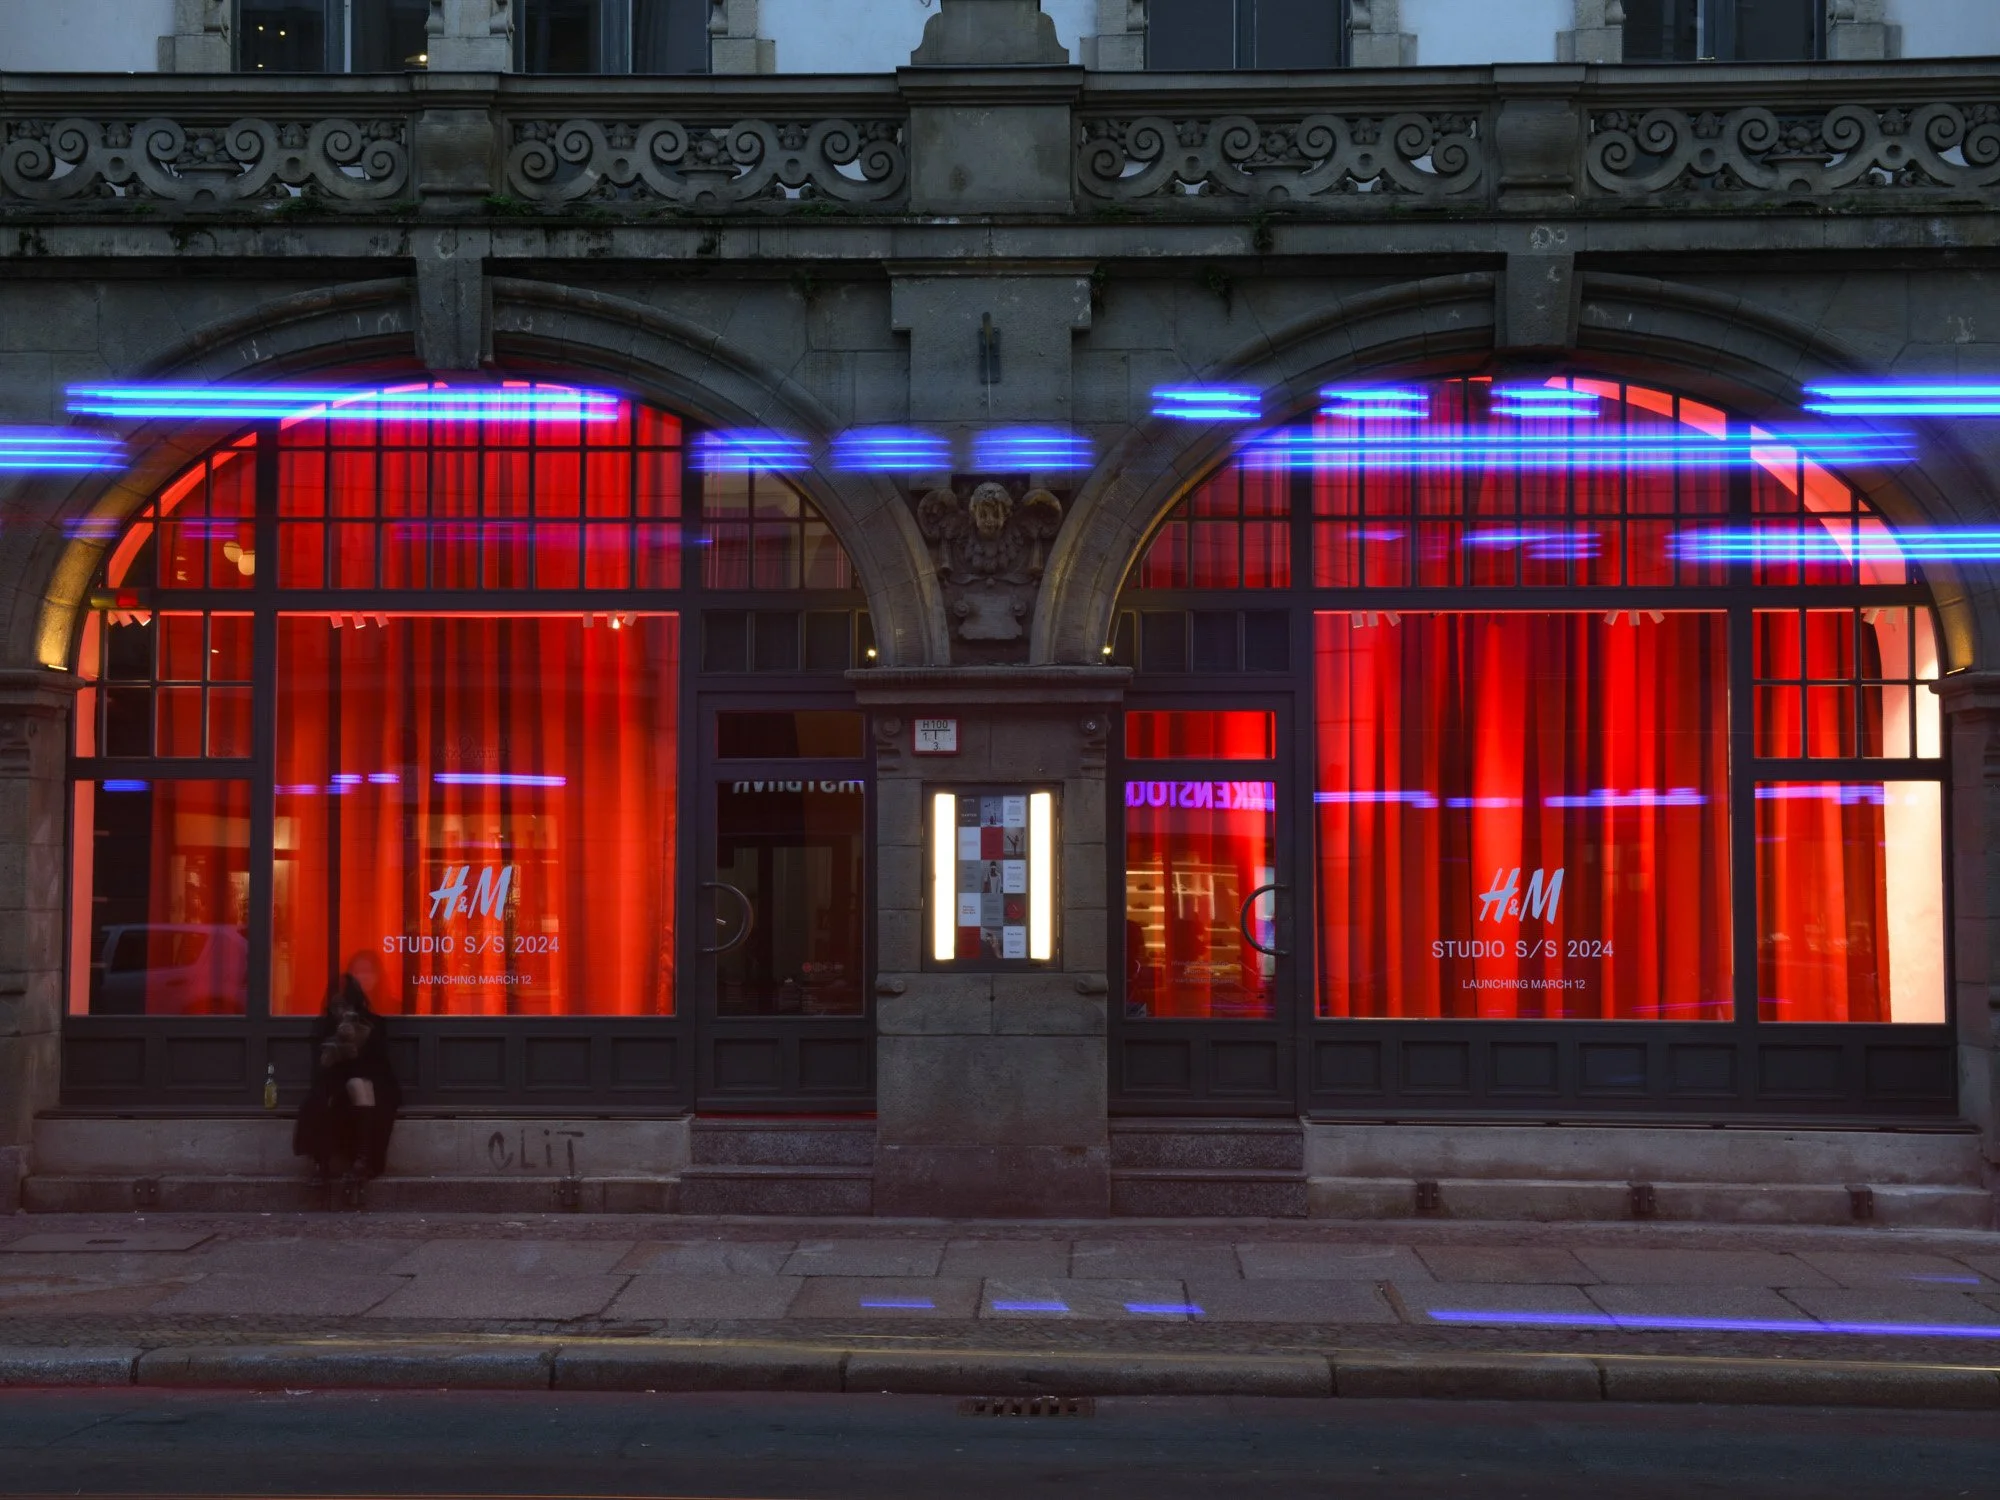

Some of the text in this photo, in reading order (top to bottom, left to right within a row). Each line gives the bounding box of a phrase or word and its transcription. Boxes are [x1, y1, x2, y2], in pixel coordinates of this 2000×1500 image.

[429, 865, 513, 921] H&M
[1478, 867, 1565, 925] H&M
[383, 936, 560, 954] STUDIO S/S 2024
[1431, 940, 1614, 958] STUDIO S/S 2024
[412, 975, 532, 985] LAUNCHING MARCH 12
[1462, 979, 1586, 989] LAUNCHING MARCH 12
